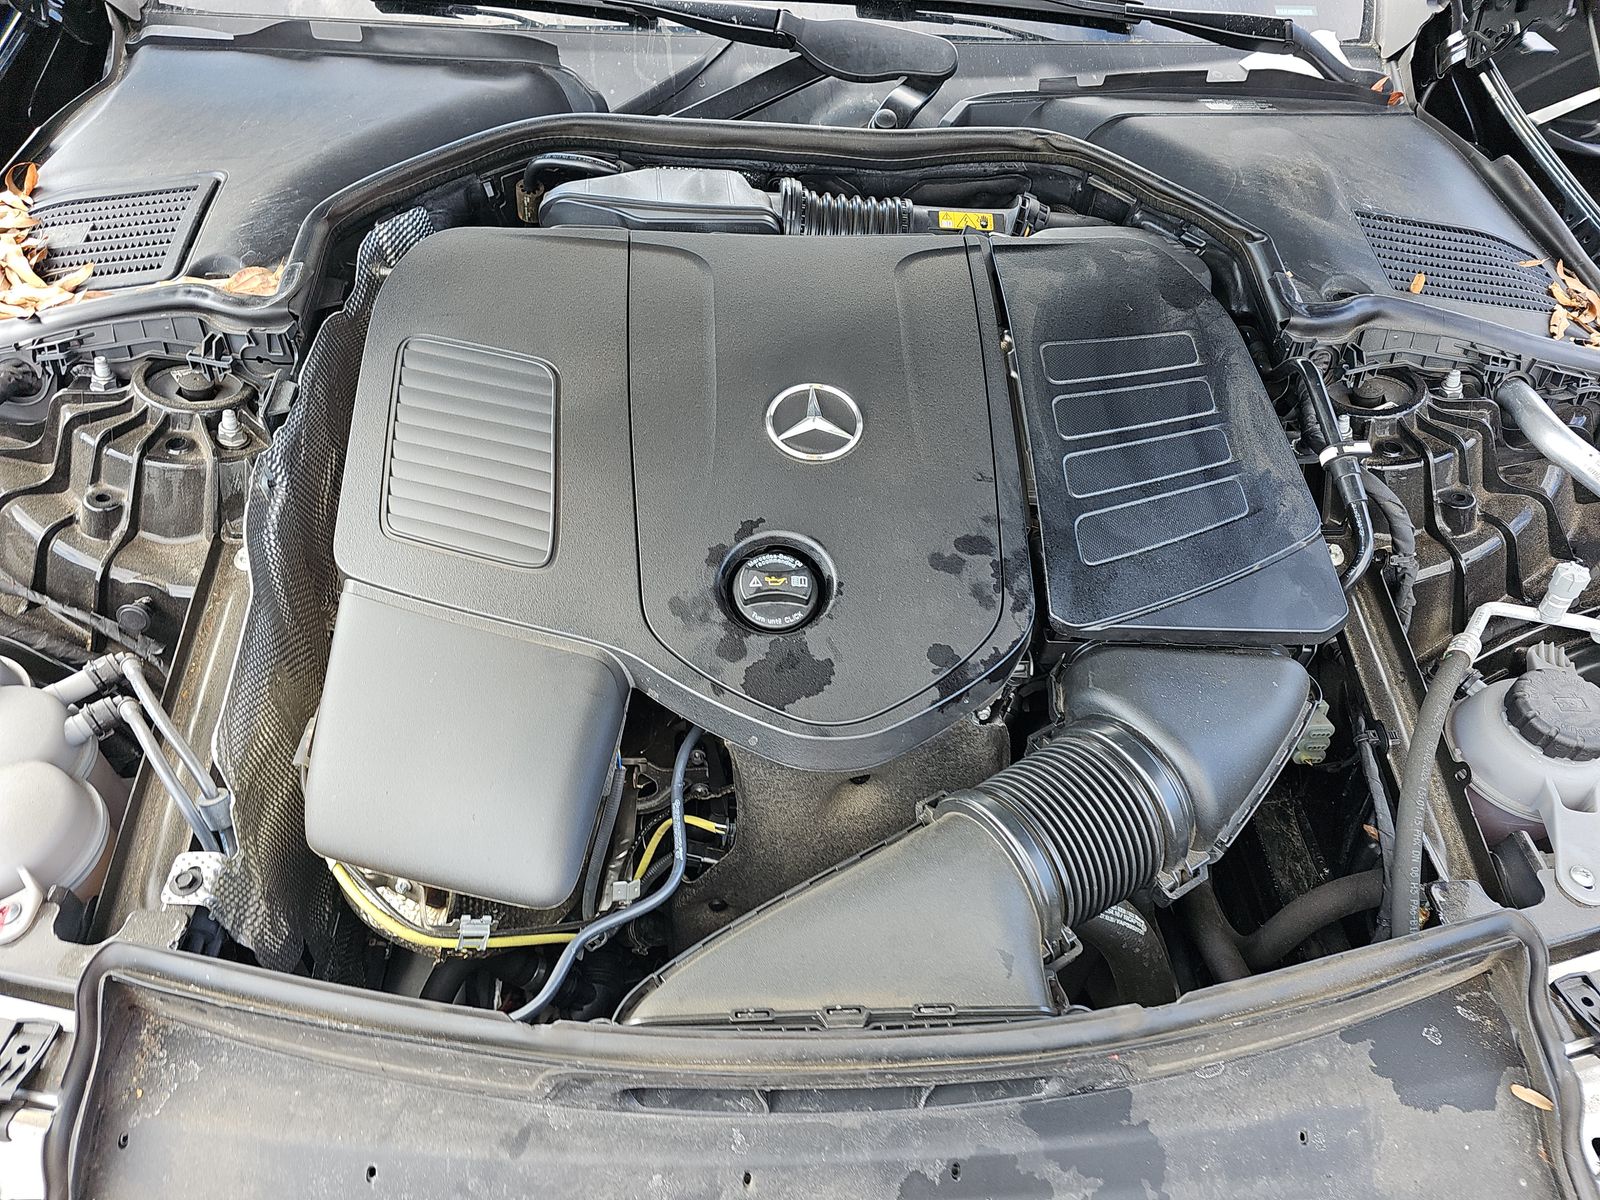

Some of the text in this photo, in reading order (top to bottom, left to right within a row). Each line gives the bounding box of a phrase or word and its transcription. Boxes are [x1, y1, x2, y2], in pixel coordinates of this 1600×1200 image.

[747, 553, 795, 568] Mercedes-Benz
[751, 611, 766, 623] Turn
[784, 611, 804, 624] CLICK
[1412, 828, 1422, 847] PHX
[1411, 850, 1421, 862] DN
